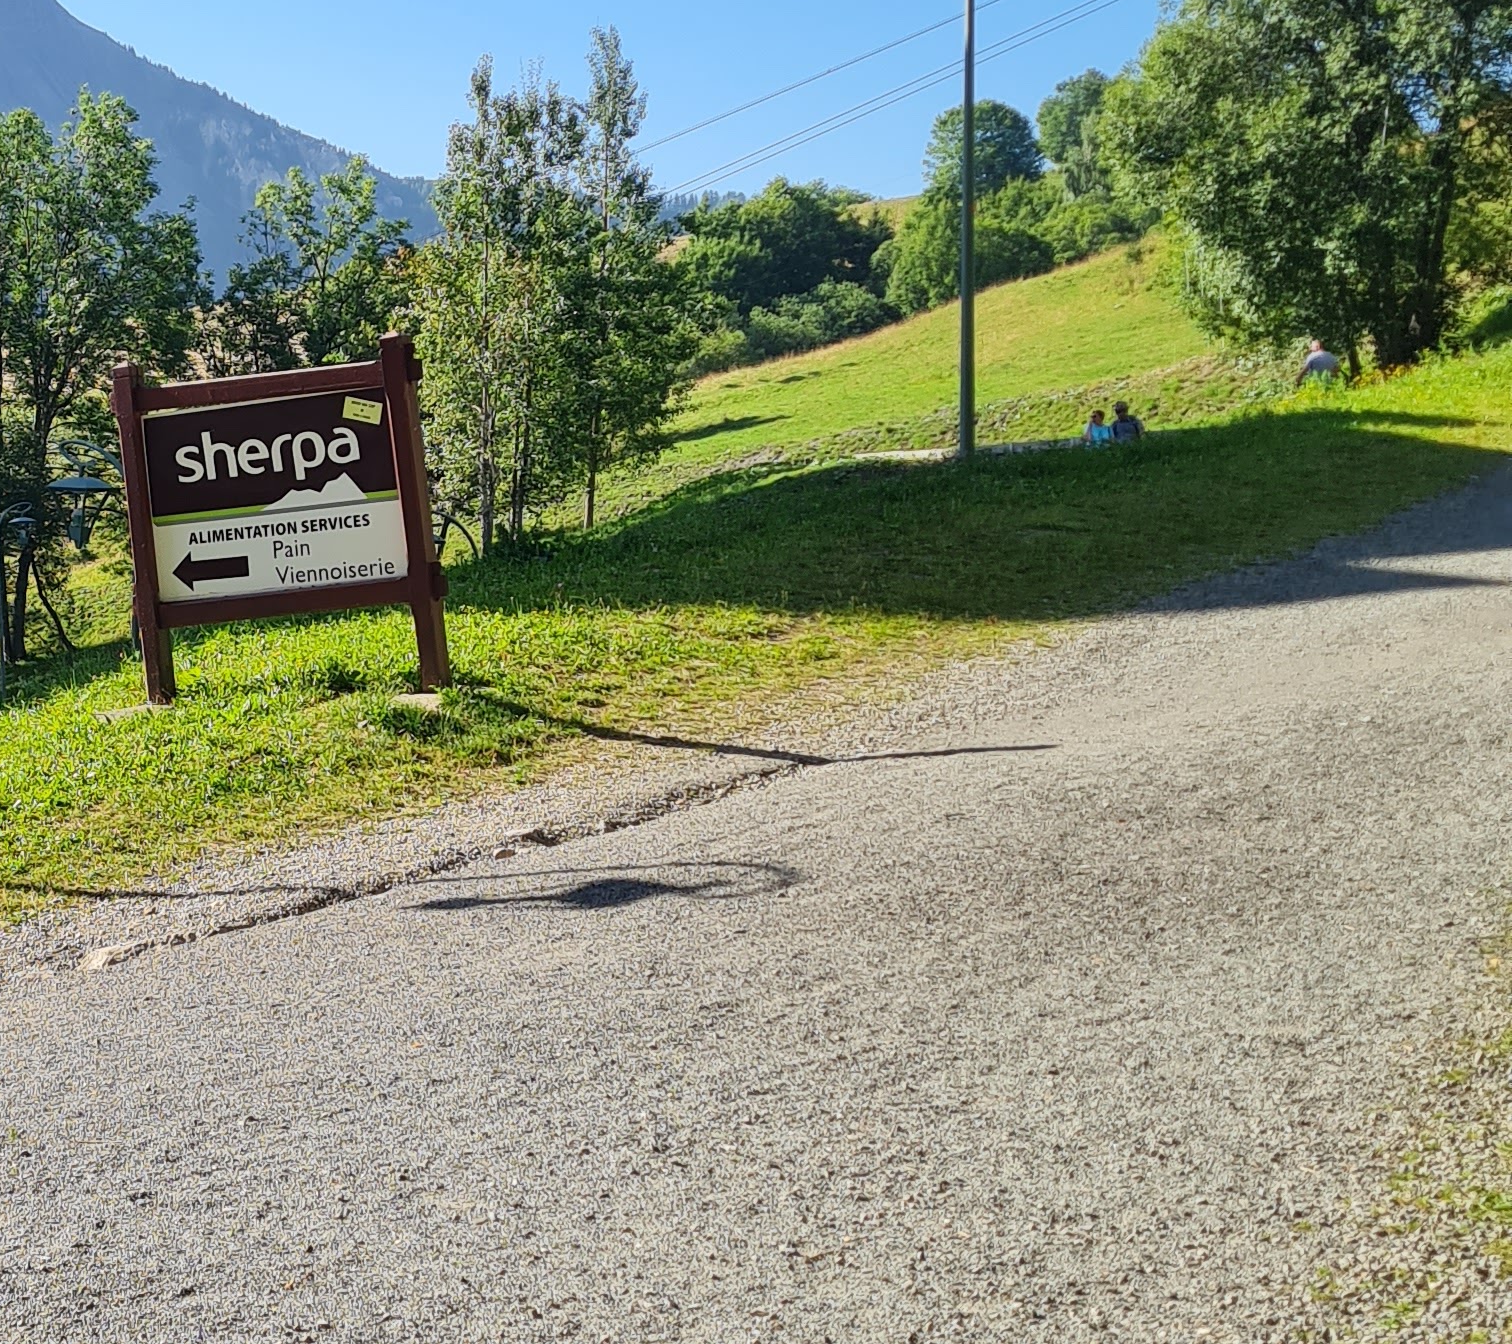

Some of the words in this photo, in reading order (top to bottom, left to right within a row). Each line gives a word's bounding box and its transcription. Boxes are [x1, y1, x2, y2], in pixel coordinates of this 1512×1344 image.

[175, 427, 361, 483] sherpa
[188, 521, 298, 545] ALIMENTATION
[301, 513, 371, 534] SERVICES
[272, 540, 311, 559] Pain
[275, 558, 396, 584] Viennoiserie
